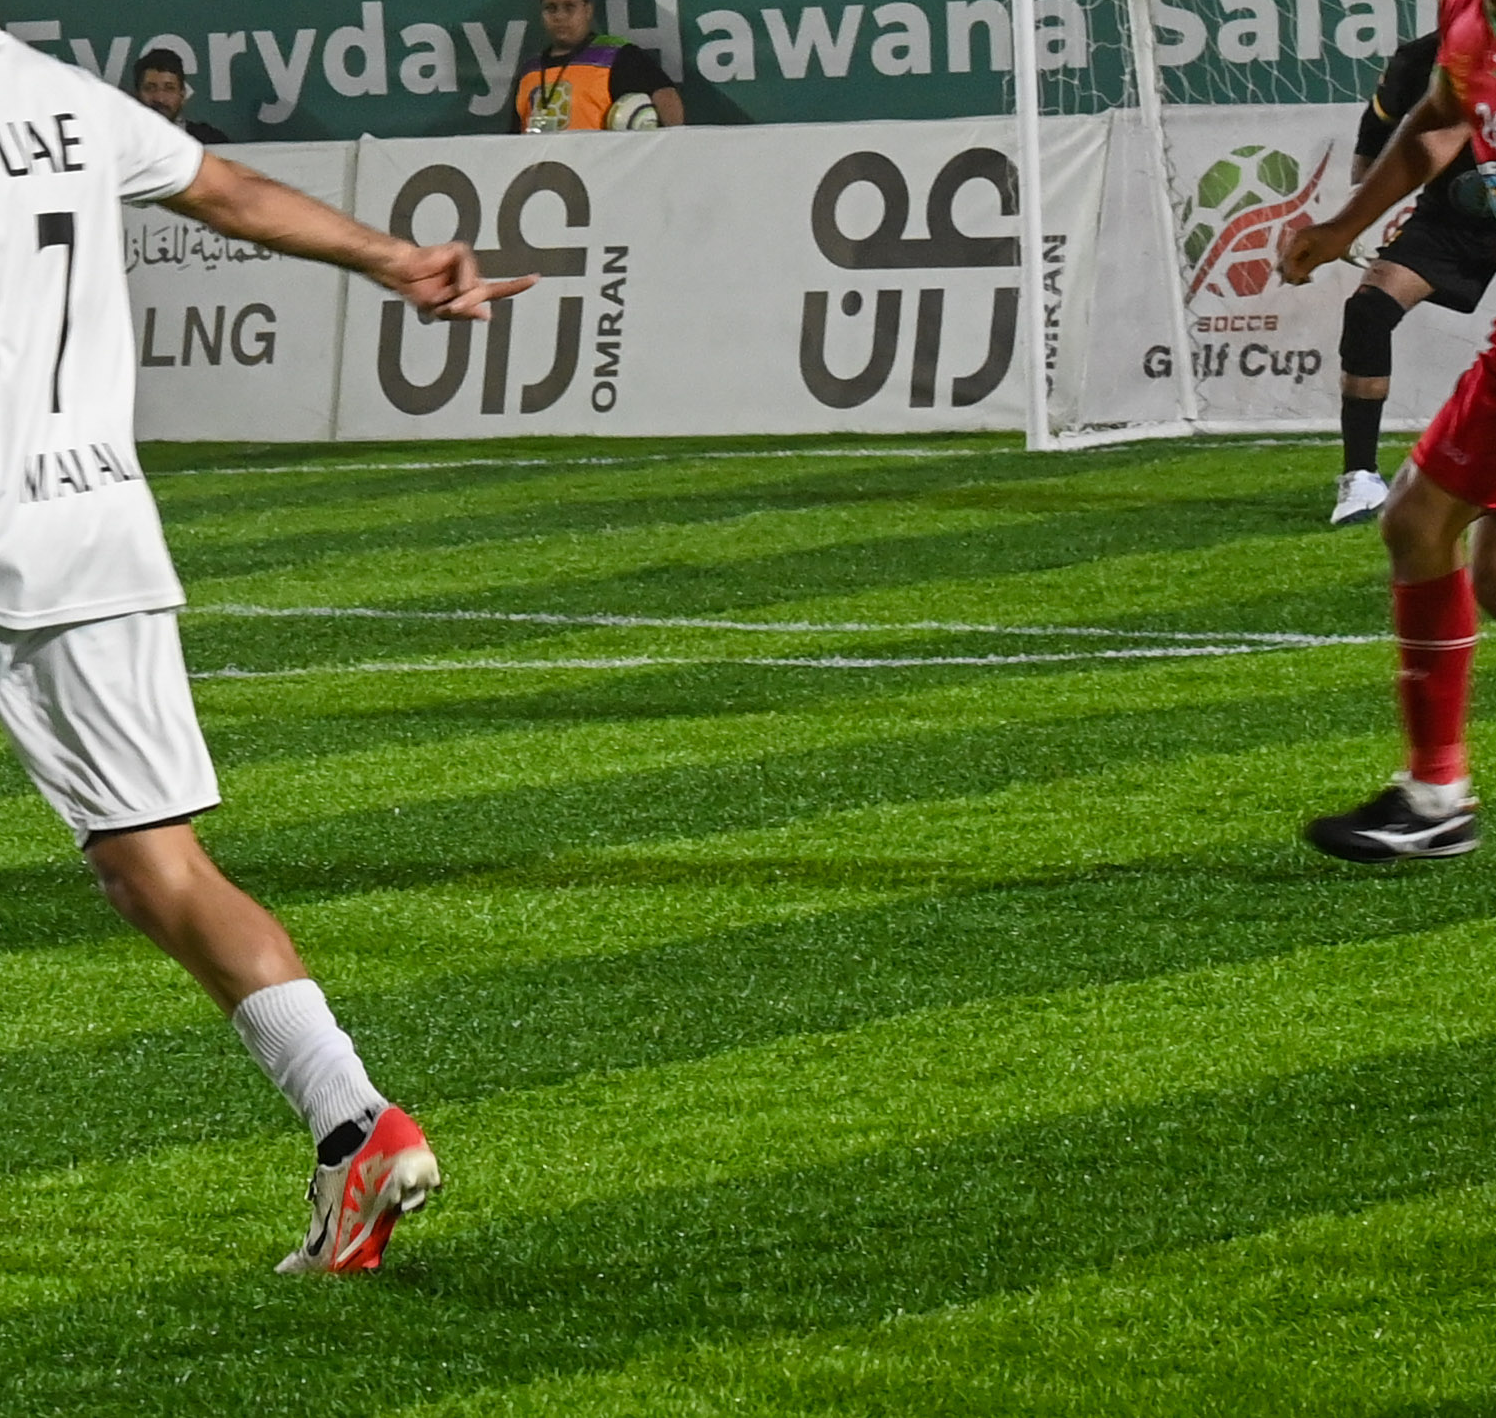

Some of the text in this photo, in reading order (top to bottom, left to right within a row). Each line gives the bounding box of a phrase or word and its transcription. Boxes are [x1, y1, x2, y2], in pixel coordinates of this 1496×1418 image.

[37, 212, 74, 413] 7
[141, 303, 276, 367] LNG
[591, 246, 629, 413] OMRAN
[1043, 235, 1067, 400] MRAN
[1239, 343, 1322, 383] Cup
